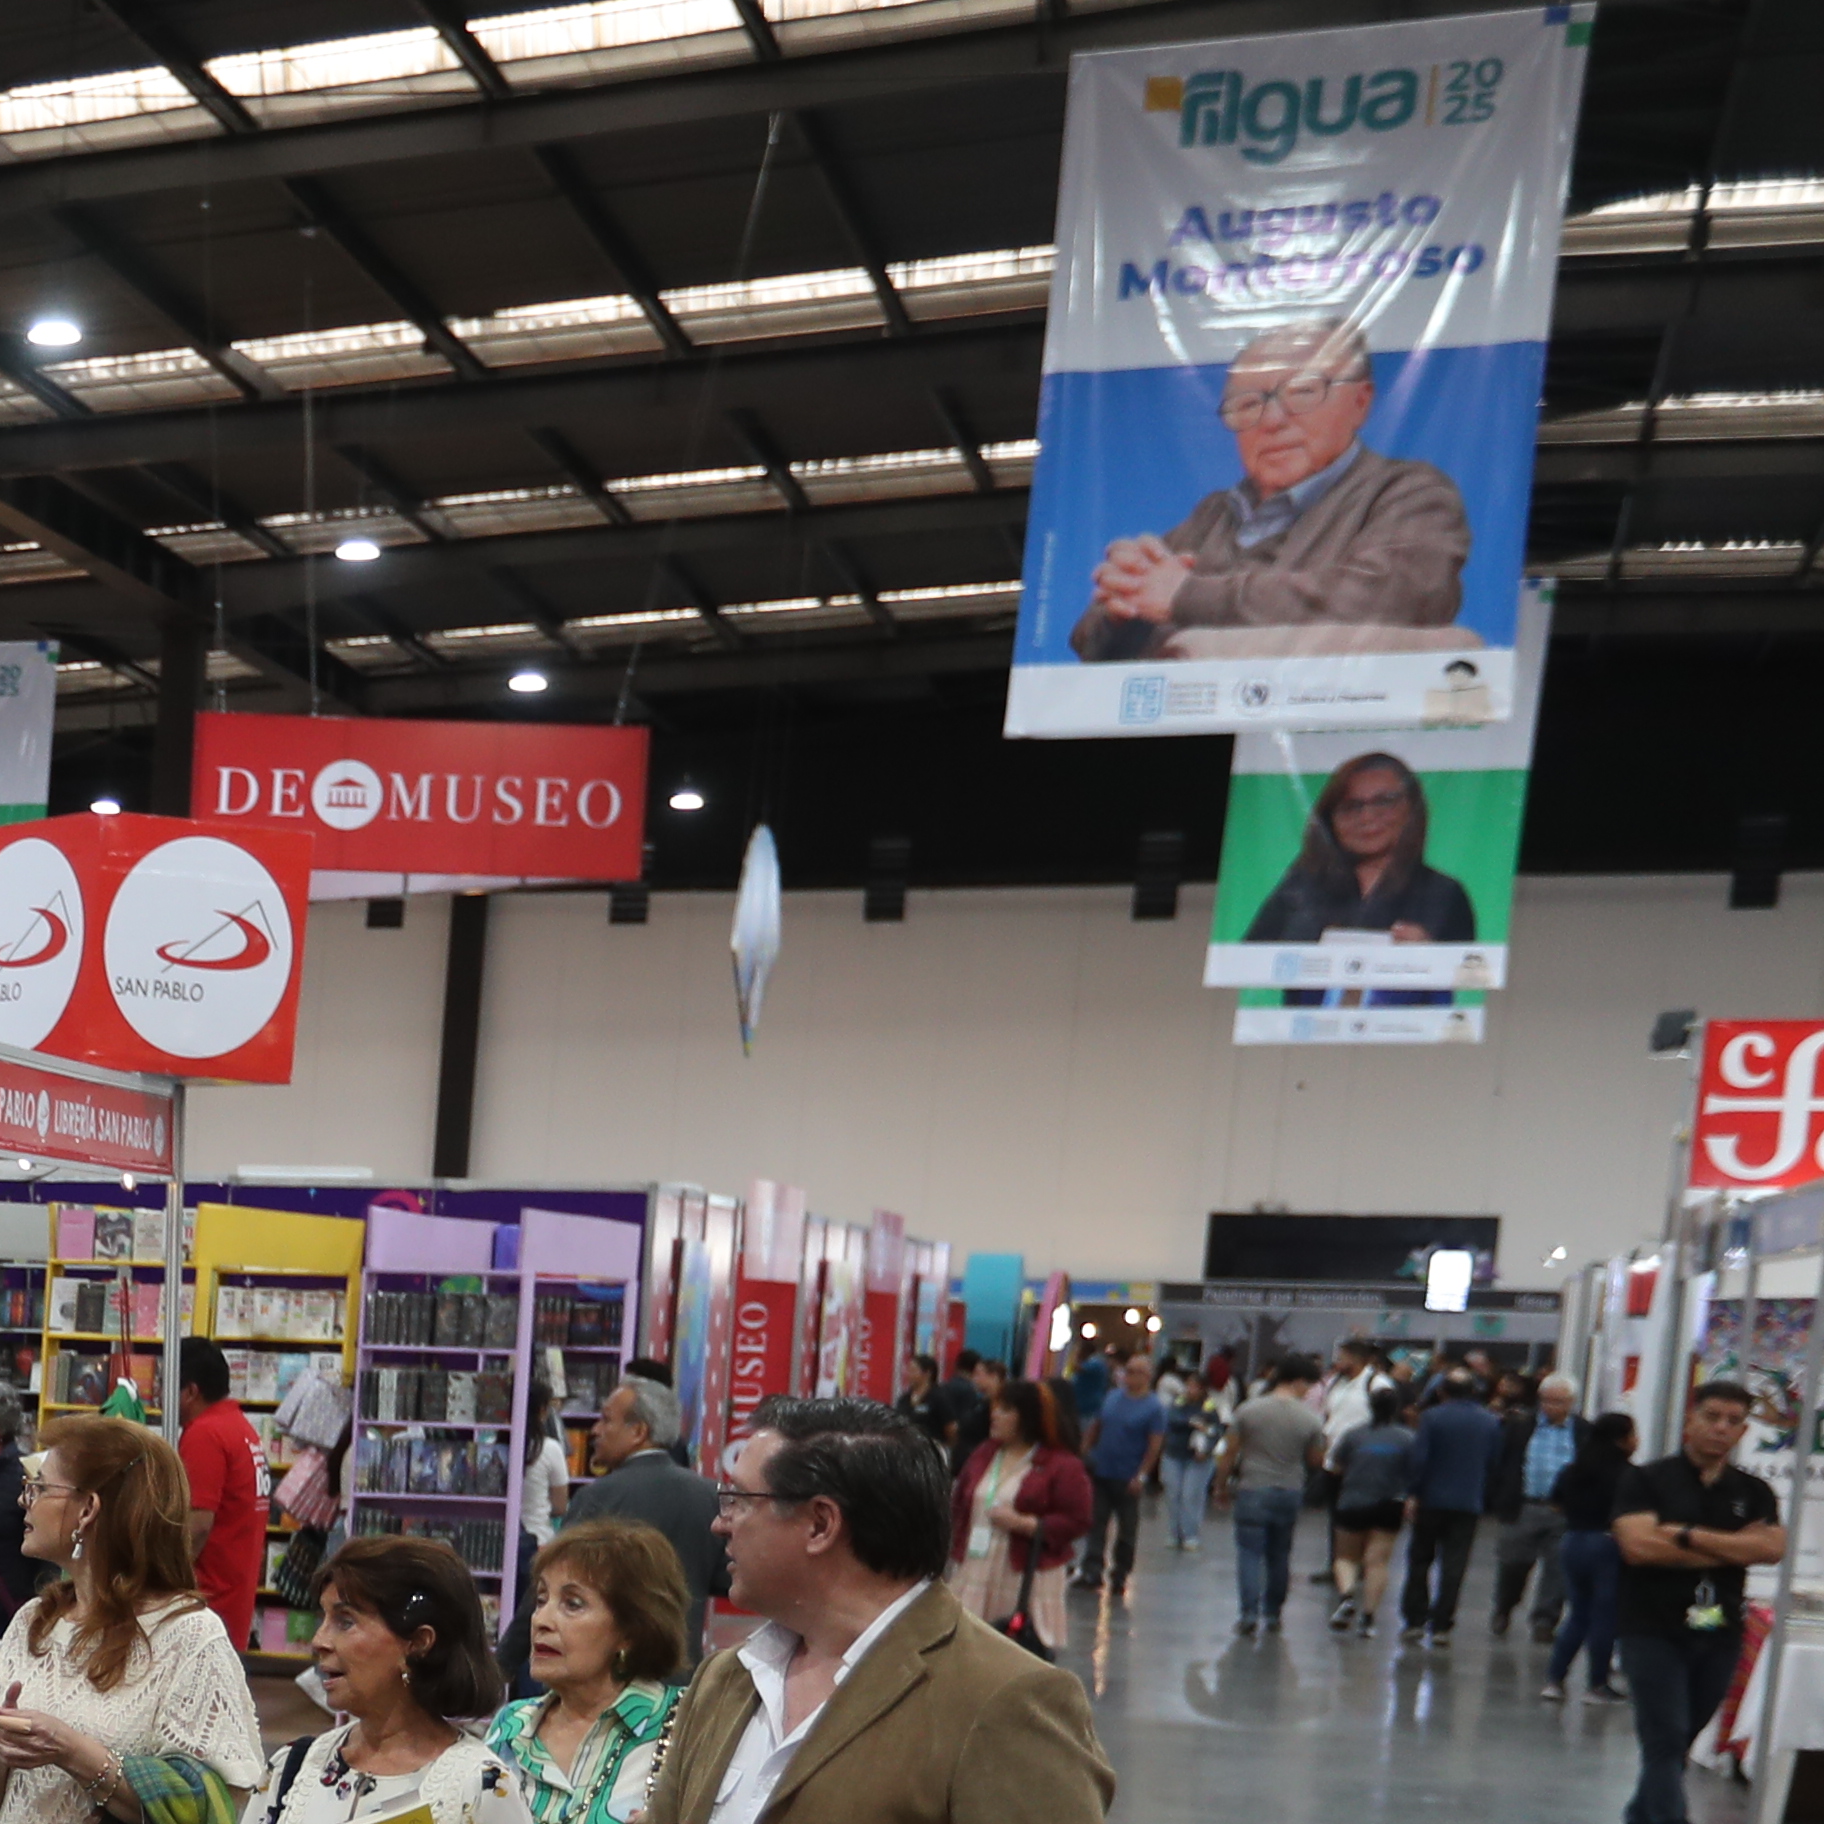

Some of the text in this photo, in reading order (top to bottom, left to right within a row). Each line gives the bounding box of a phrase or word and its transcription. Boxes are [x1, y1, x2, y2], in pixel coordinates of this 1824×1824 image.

[1445, 57, 1503, 92] 20
[1441, 92, 1496, 126] 25
[1168, 190, 1441, 249] Augusto
[1118, 238, 1484, 300] Monterroso
[215, 766, 622, 829] DE MUSEO
[115, 976, 204, 1003] SAN PABLO
[54, 1095, 97, 1140] LIBRERÍA
[98, 1109, 120, 1143] SAN
[120, 1114, 151, 1150] PABLO
